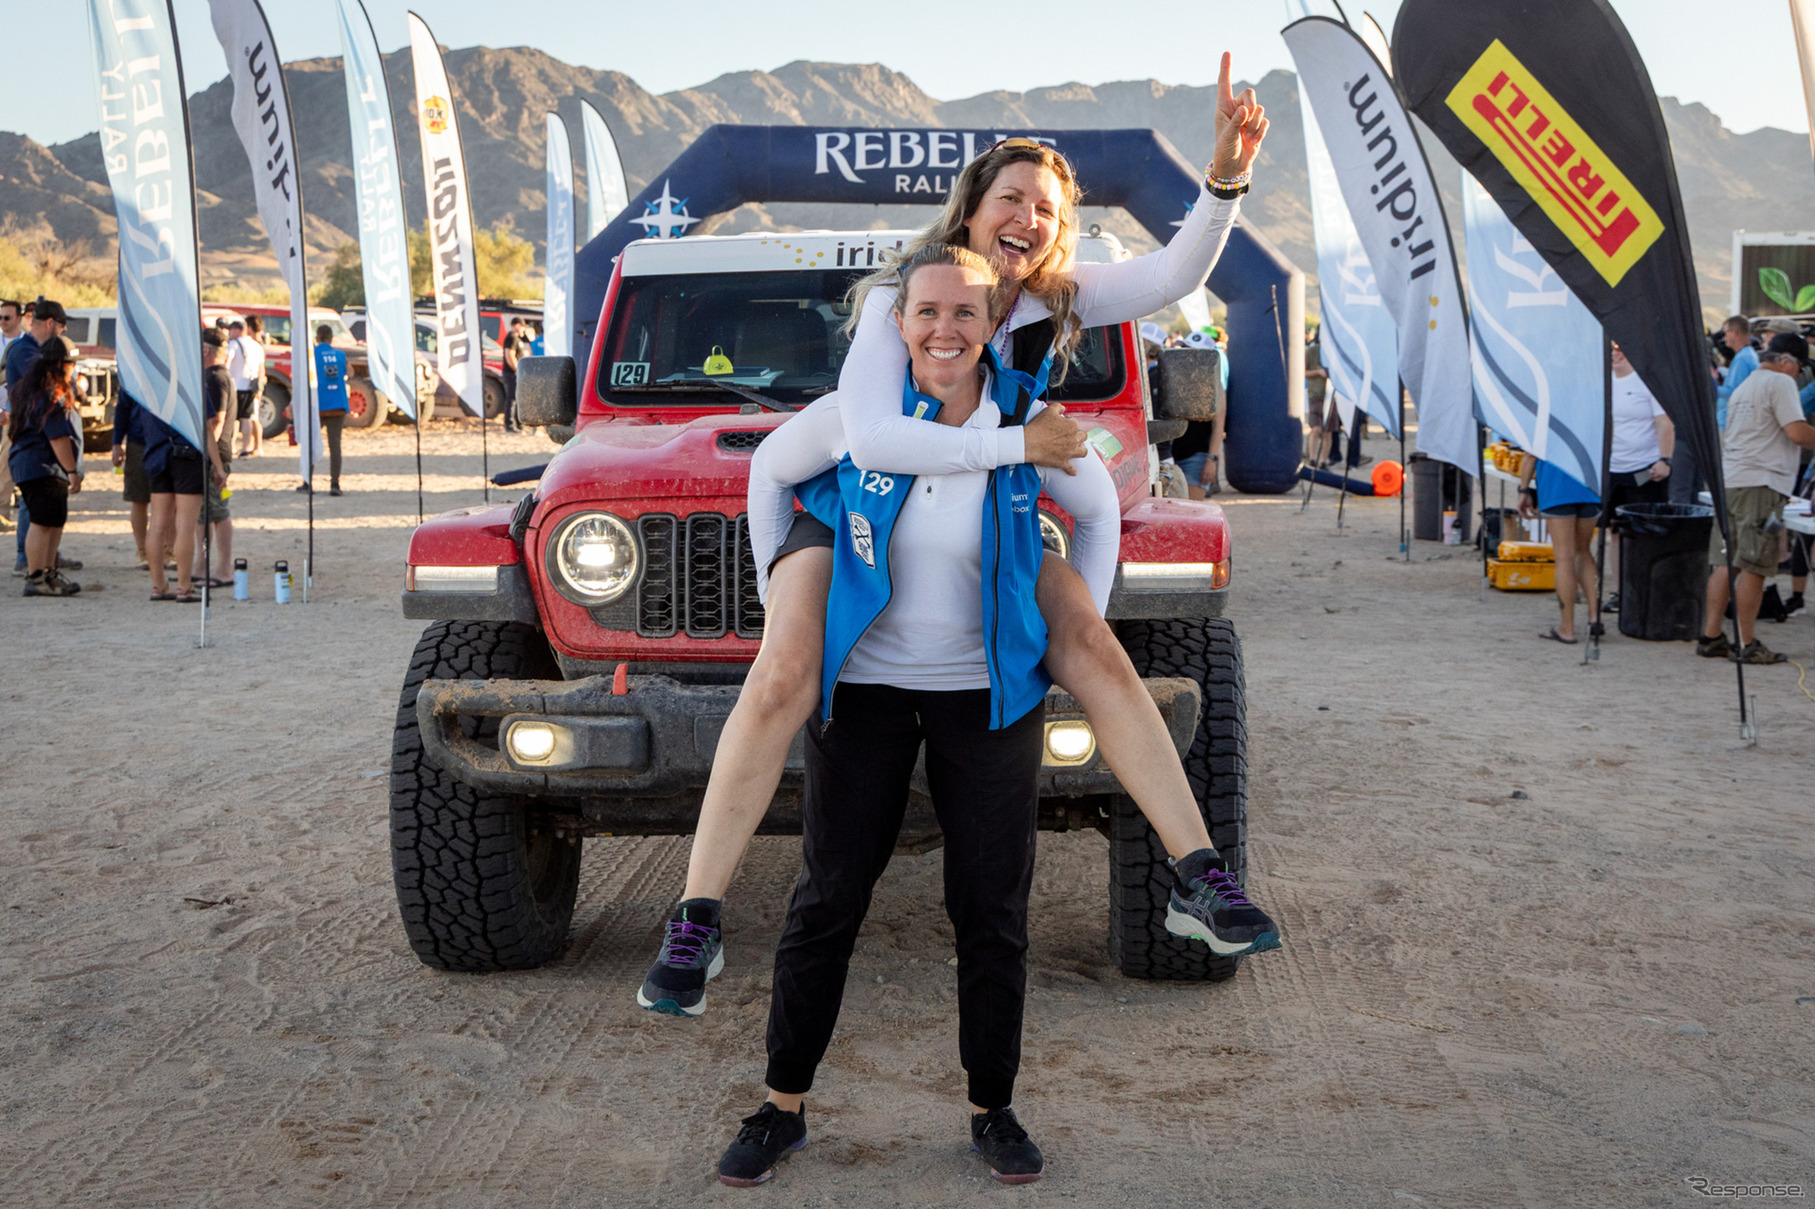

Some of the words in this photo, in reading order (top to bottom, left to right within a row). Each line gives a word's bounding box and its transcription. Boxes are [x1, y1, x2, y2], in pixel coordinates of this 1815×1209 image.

[1472, 71, 1641, 259] PIRELLI
[614, 364, 646, 385] 129
[859, 469, 895, 497] 129
